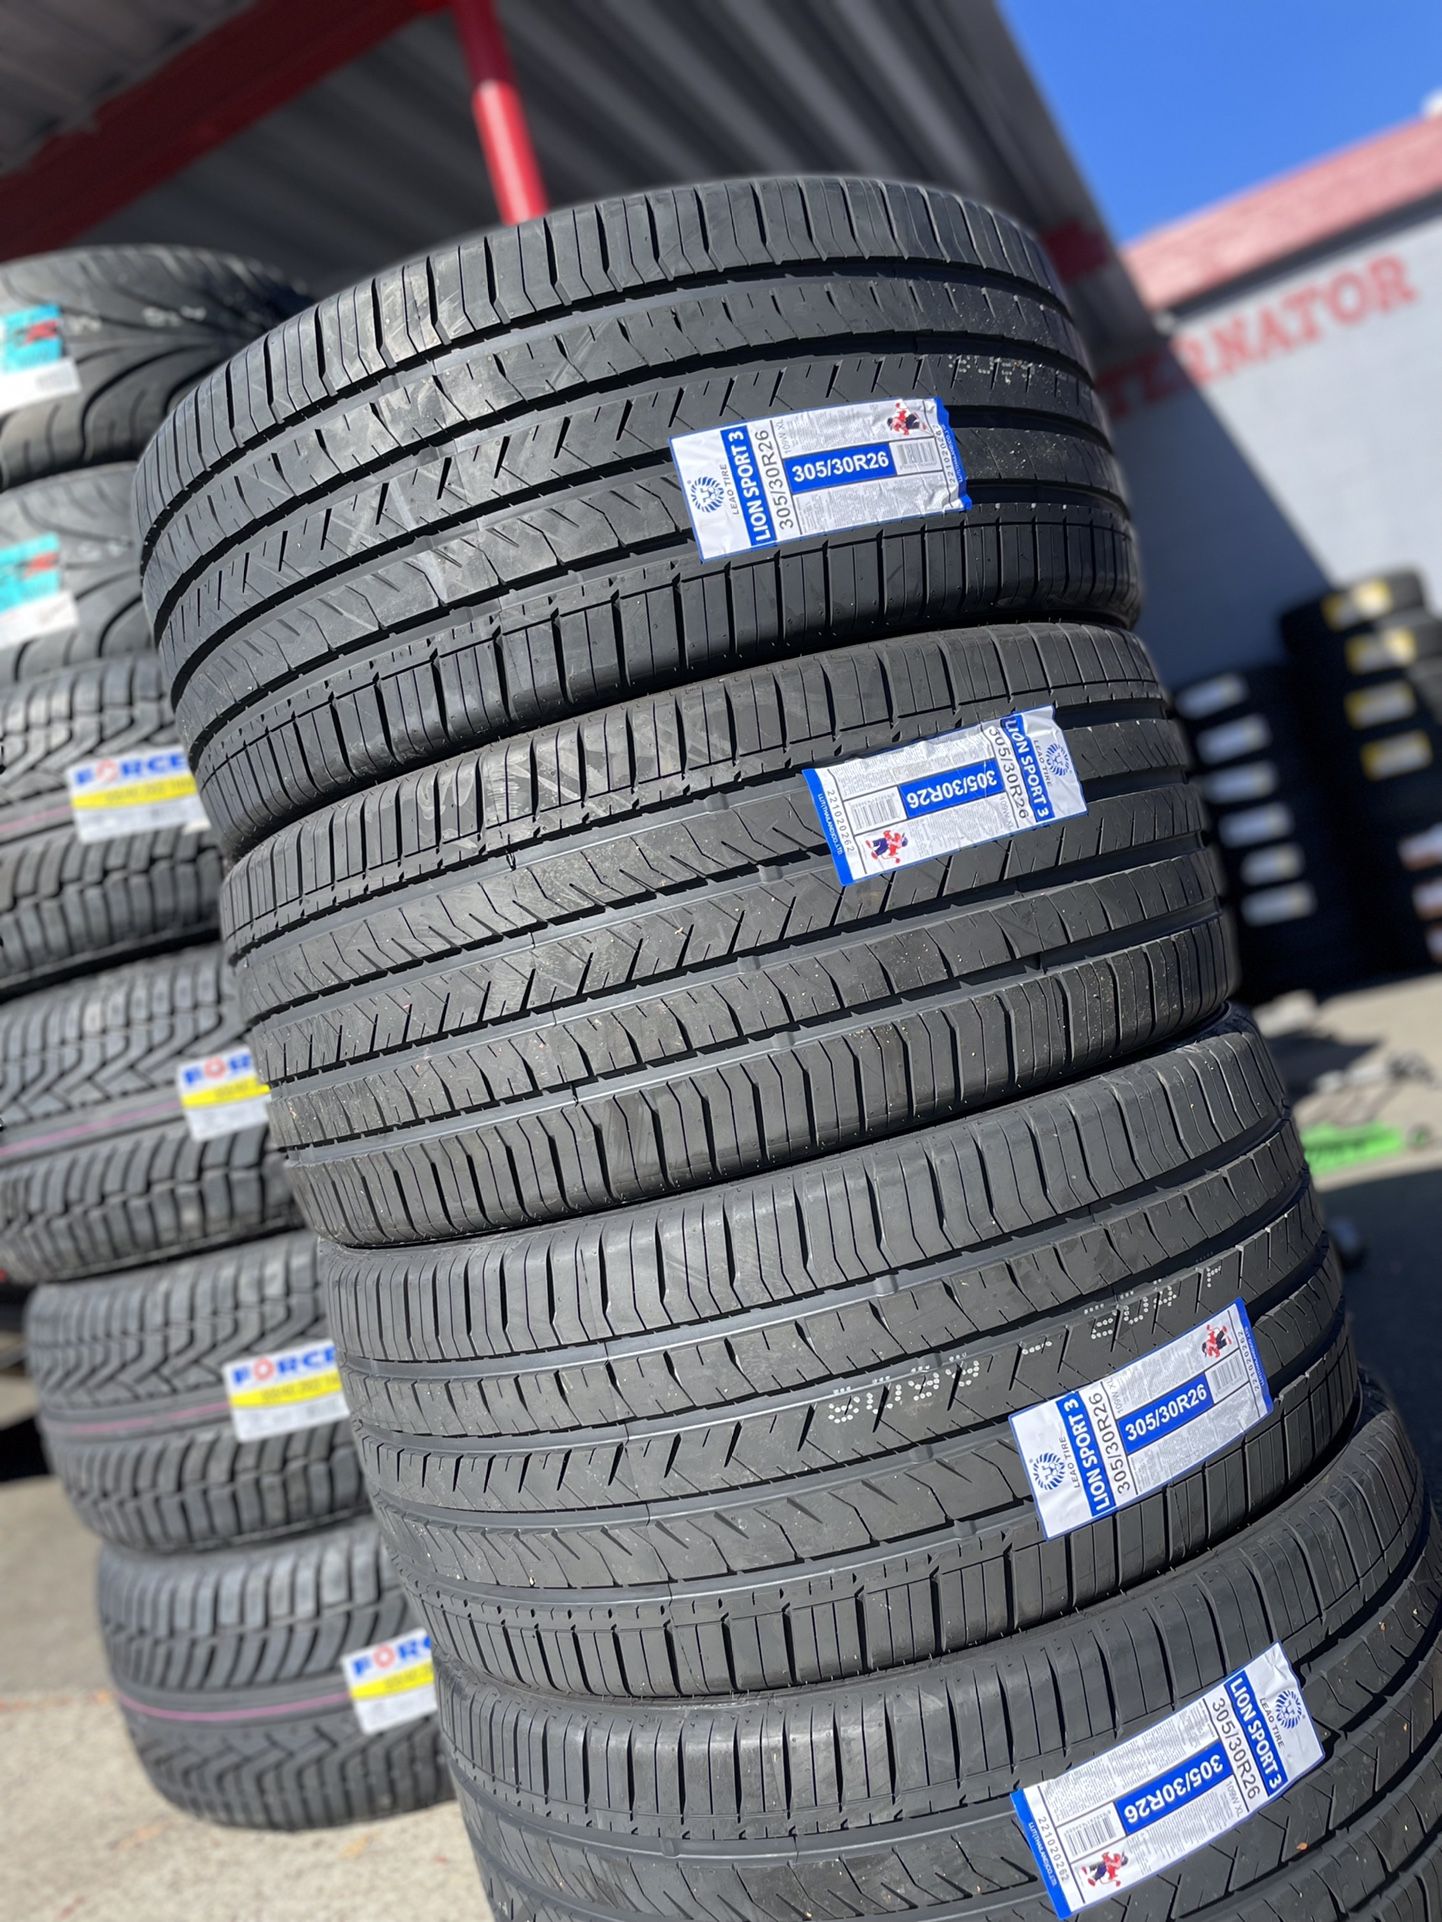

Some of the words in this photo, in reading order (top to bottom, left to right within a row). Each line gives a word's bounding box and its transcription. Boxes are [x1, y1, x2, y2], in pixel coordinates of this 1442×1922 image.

[728, 430, 744, 442] 3
[720, 464, 731, 487] TIRE
[731, 445, 759, 498] SPORT
[755, 430, 794, 530] 305/30R26
[792, 451, 889, 482] 305/30R26
[746, 499, 771, 542] LION
[907, 770, 997, 809] 305/30R26
[989, 727, 1029, 819] 305/30R26
[1005, 720, 1029, 753] LION
[1021, 755, 1047, 804] SPORT
[1037, 807, 1049, 817] 3
[1043, 766, 1052, 786] TIRE
[828, 790, 855, 852] 221020262
[1063, 1398, 1079, 1412] 3
[1125, 1384, 1206, 1440] 305/30R26
[1059, 1436, 1071, 1459] TIRE
[1068, 1414, 1098, 1468] SPORT
[1089, 1392, 1130, 1494] 305/30R26
[1086, 1467, 1110, 1511] LION
[1212, 1698, 1260, 1799] 305/30R26
[1230, 1677, 1256, 1722] LION
[1248, 1719, 1278, 1775] SPORT
[1269, 1774, 1282, 1789] 3
[1272, 1726, 1285, 1748] TIRE
[1124, 1754, 1223, 1824] 305/30R26
[1038, 1816, 1070, 1881] 221020262
